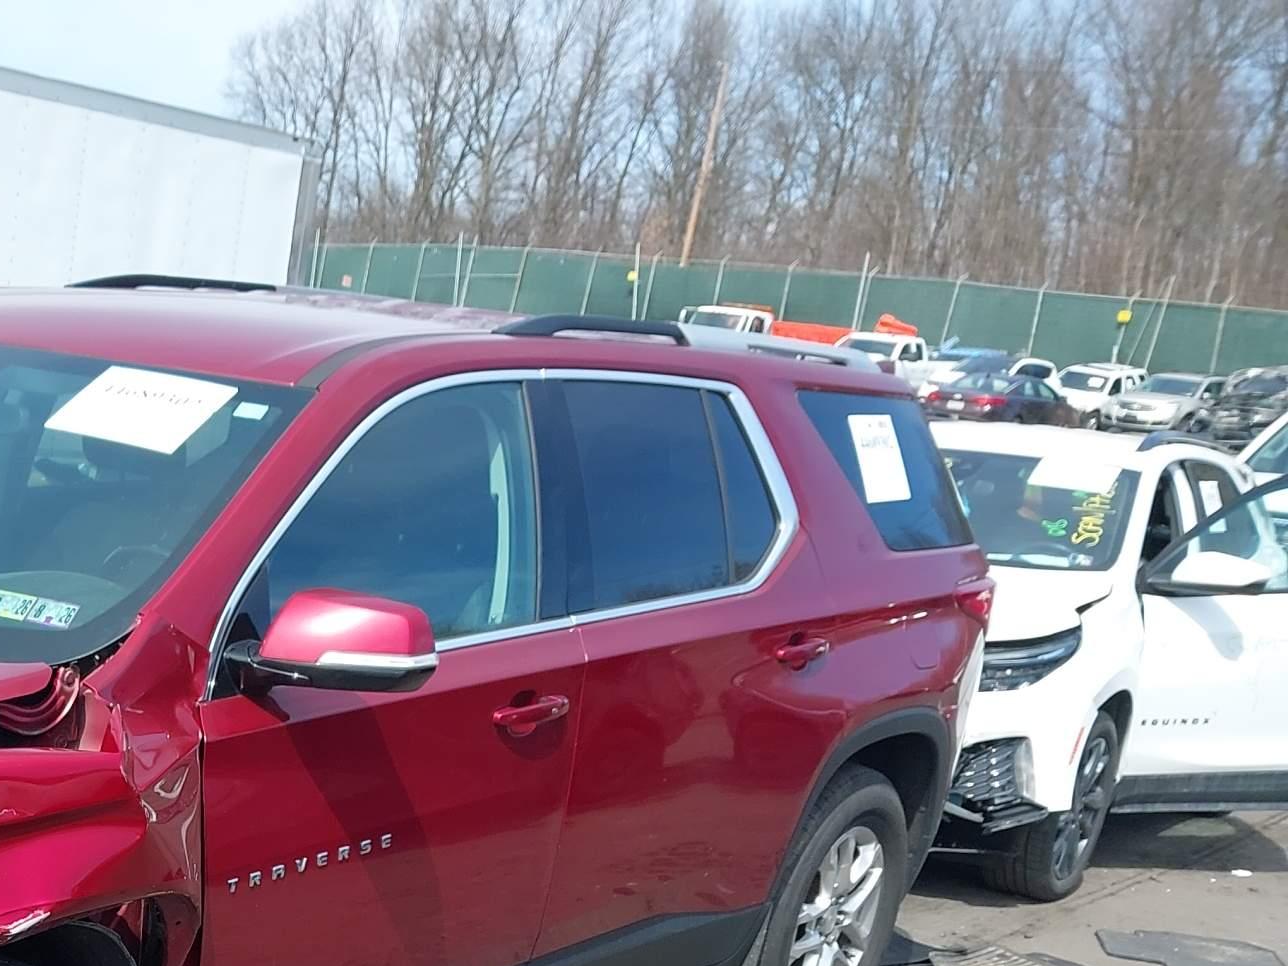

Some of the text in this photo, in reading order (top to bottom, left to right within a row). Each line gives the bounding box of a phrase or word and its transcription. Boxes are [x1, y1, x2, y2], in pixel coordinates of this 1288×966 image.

[15, 599, 33, 616] 26
[59, 607, 76, 625] 26
[1140, 718, 1210, 727] EQUINOX
[226, 833, 393, 894] TRAVERSE
